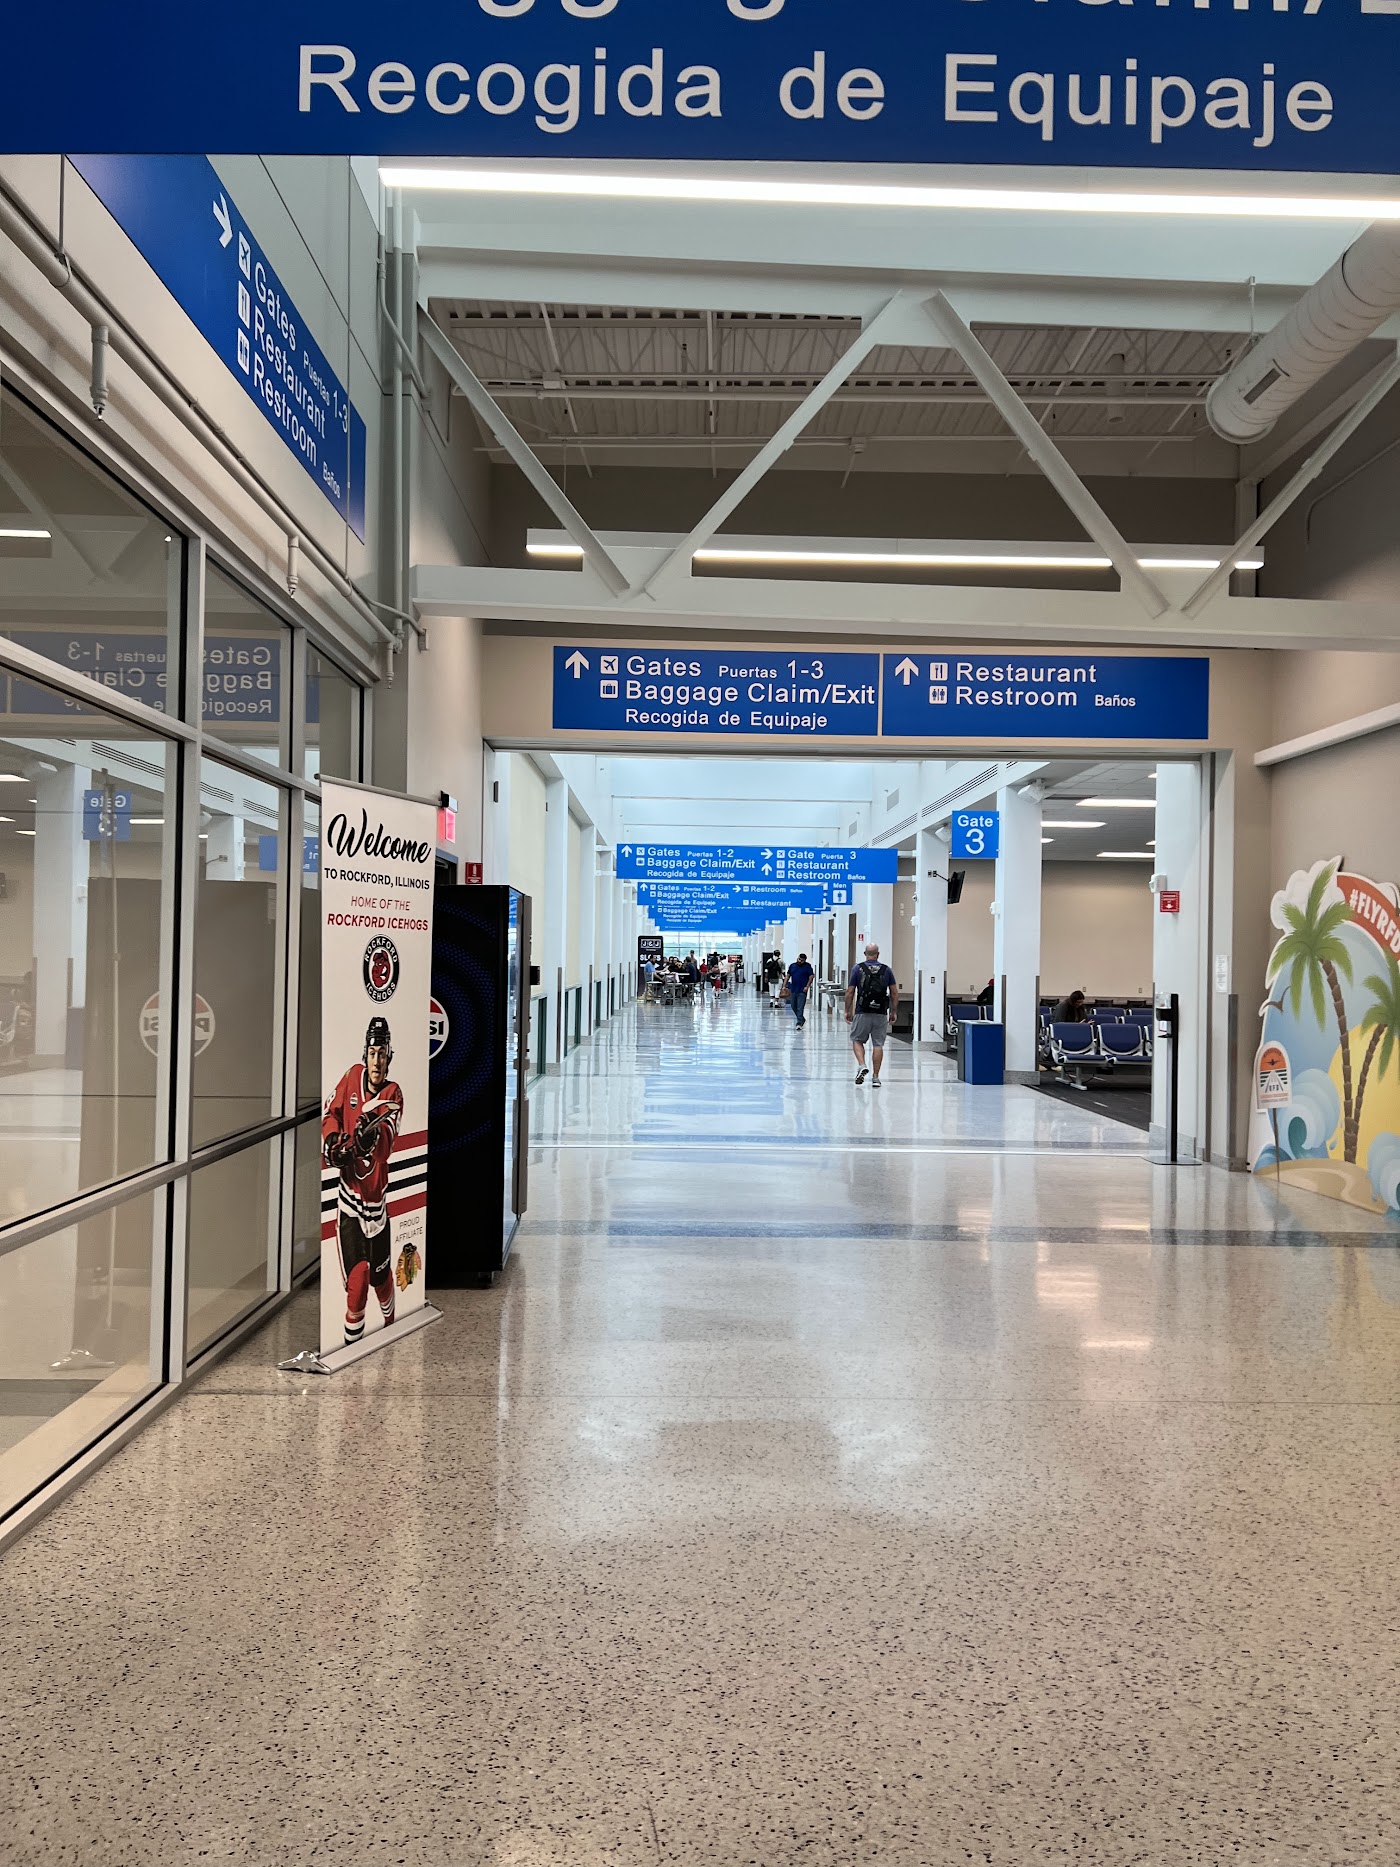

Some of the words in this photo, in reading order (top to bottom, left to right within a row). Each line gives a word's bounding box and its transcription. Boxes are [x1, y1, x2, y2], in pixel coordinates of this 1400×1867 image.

[298, 44, 722, 133] Recogida
[779, 51, 885, 120] de
[945, 53, 1334, 147] Equipaje
[254, 262, 297, 352] Gates
[303, 350, 330, 406] Puertas
[333, 389, 349, 434] 1-3
[254, 305, 326, 439] Restaurant
[253, 352, 317, 467] Restroom
[323, 461, 341, 499] Baños
[626, 656, 702, 677] Gates
[719, 666, 777, 679] Puertas
[787, 660, 824, 679] 1-3
[956, 662, 1097, 683] Restaurant
[625, 679, 739, 706] Baggage
[748, 683, 875, 704] Claim/Exit
[955, 686, 1078, 706] Restroom
[1094, 694, 1136, 707] Baños
[625, 708, 709, 727] Recogida
[718, 710, 740, 726] de
[750, 711, 828, 729] Equipaje
[957, 815, 994, 827] Gate
[327, 808, 432, 863] Welcome
[965, 828, 985, 854] 3
[647, 847, 681, 857] Gates
[716, 849, 734, 858] 1-2
[788, 850, 815, 859] Gate
[850, 851, 857, 860] 3
[647, 858, 697, 869] Baggage
[700, 859, 756, 869] Claim/Exit
[788, 860, 849, 870] Restaurant
[324, 867, 338, 880] TO
[340, 869, 394, 888] ROCKFORD,
[395, 876, 430, 890] ILLINOIS
[647, 870, 684, 878] Recogida
[700, 871, 735, 879] Equipaje
[788, 871, 841, 880] Restroom
[351, 895, 377, 909] HOME
[379, 898, 392, 909] OF
[395, 899, 411, 911] THE
[657, 892, 691, 900] Baggage
[327, 913, 386, 929] ROCKFORD
[387, 918, 429, 931] ICEHOGS
[364, 938, 399, 963] ROCKFORD
[366, 982, 397, 1001] ICEHOGS
[399, 1216, 420, 1229] PROUD
[395, 1226, 424, 1243] AFFILIATE
